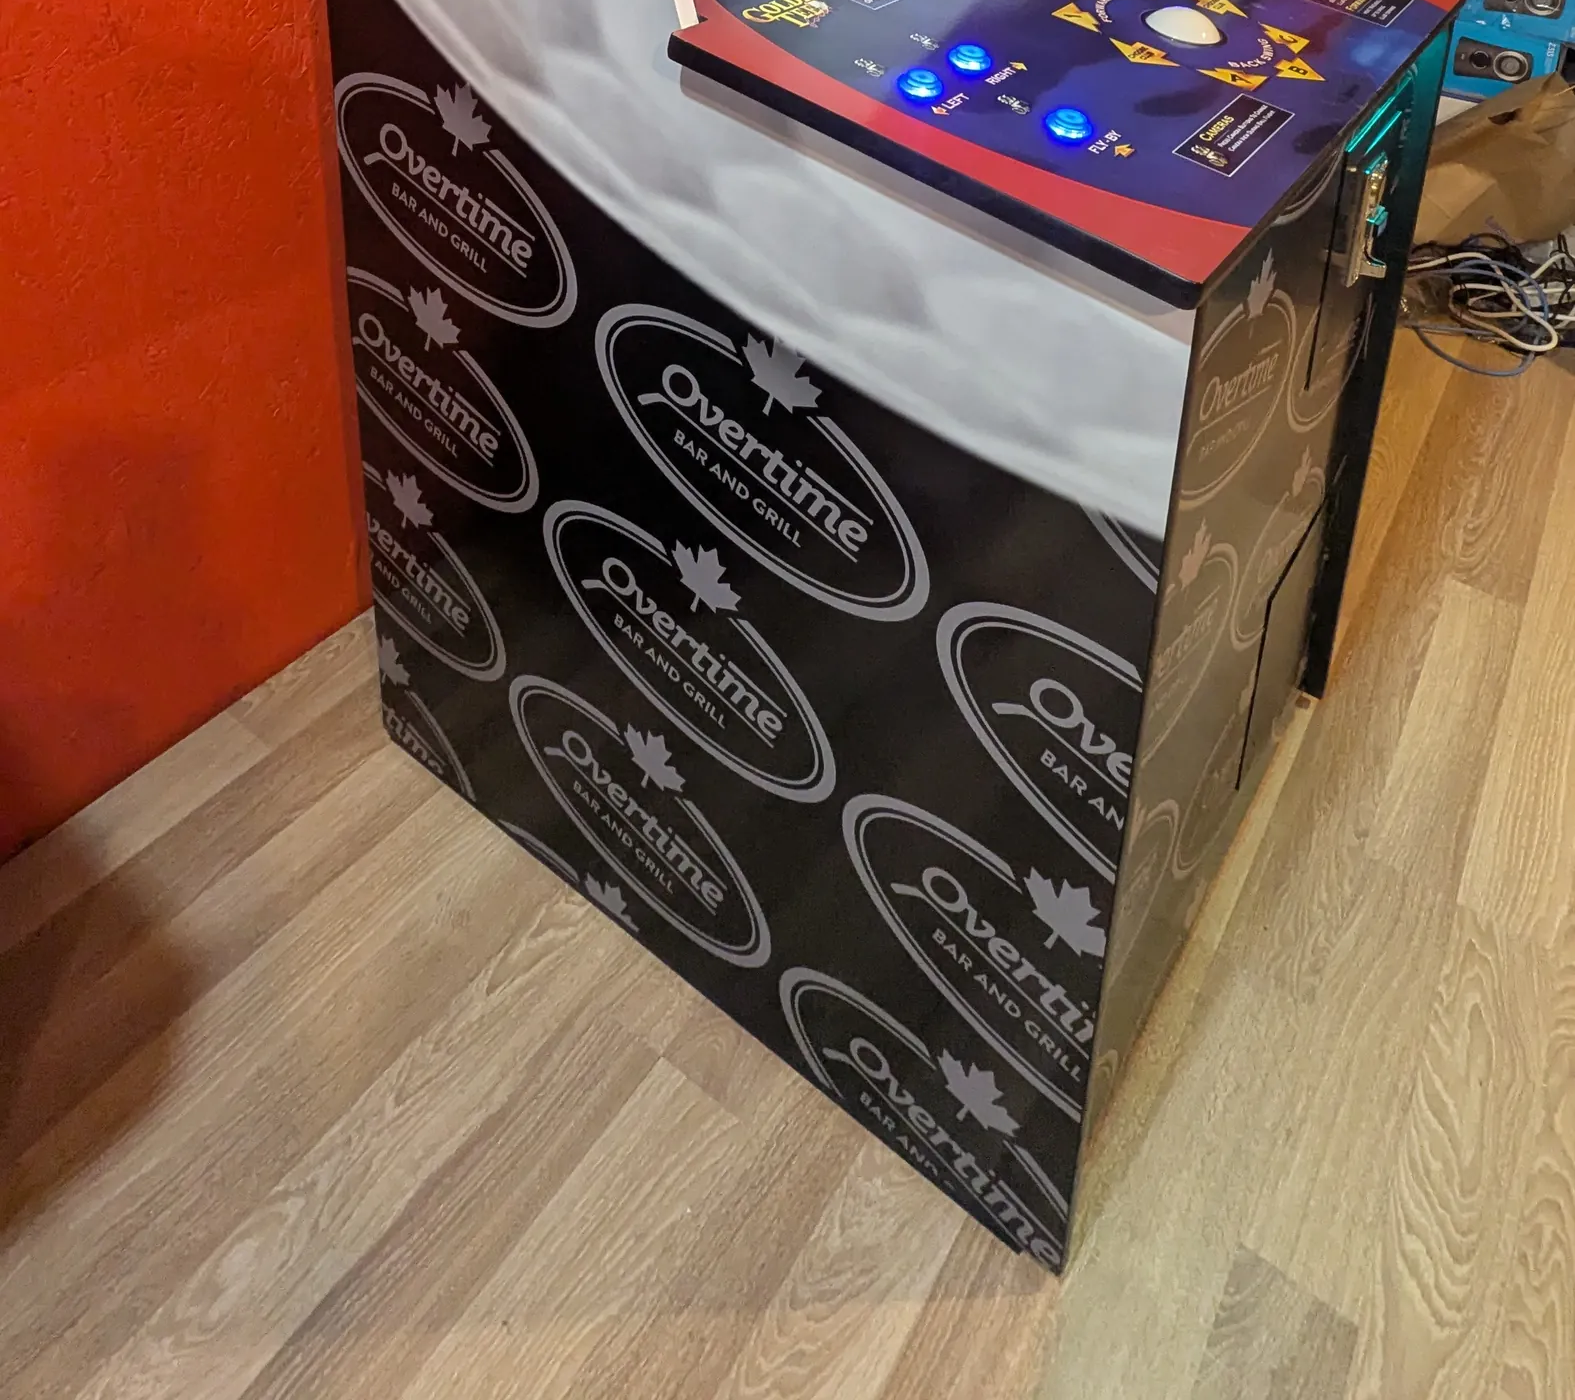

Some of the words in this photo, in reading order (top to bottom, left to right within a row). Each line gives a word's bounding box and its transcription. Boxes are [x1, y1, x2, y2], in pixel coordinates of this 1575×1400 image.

[984, 67, 1017, 87] RIGHT
[1227, 59, 1265, 69] BACK
[1257, 38, 1274, 62] SWING
[1229, 73, 1252, 85] A
[1288, 65, 1308, 75] B
[941, 92, 970, 110] LEFT
[1088, 129, 1122, 154] FLY-BY
[1199, 114, 1235, 142] CAMERAS
[379, 123, 533, 268] Overtime
[391, 182, 417, 212] BAR
[418, 203, 449, 238] AND
[450, 233, 487, 274] GRILL
[358, 312, 500, 458] Overtime
[370, 366, 393, 395] BAR
[395, 391, 423, 422] AND
[424, 418, 458, 458] GRILL
[1200, 352, 1279, 422] Overtime
[662, 364, 868, 552] Overtime
[673, 429, 709, 466] BAR
[709, 463, 750, 500] AND
[752, 497, 801, 548] GRILL
[375, 560, 399, 589] AND
[602, 557, 783, 739] Overtime
[613, 613, 644, 648] BAR
[645, 648, 681, 683] AND
[683, 680, 726, 730] GRILL
[562, 730, 724, 909] Overtime
[1040, 749, 1087, 796] BAR
[1088, 796, 1124, 831] AN
[573, 781, 601, 814] BAR
[601, 814, 634, 848] AND
[635, 846, 674, 895] GRILL
[932, 928, 973, 972] BAR
[973, 973, 1021, 1018] AND
[1024, 1019, 1081, 1083] GRILL
[850, 1037, 1060, 1265] Overtime
[859, 1091, 895, 1131] BAR
